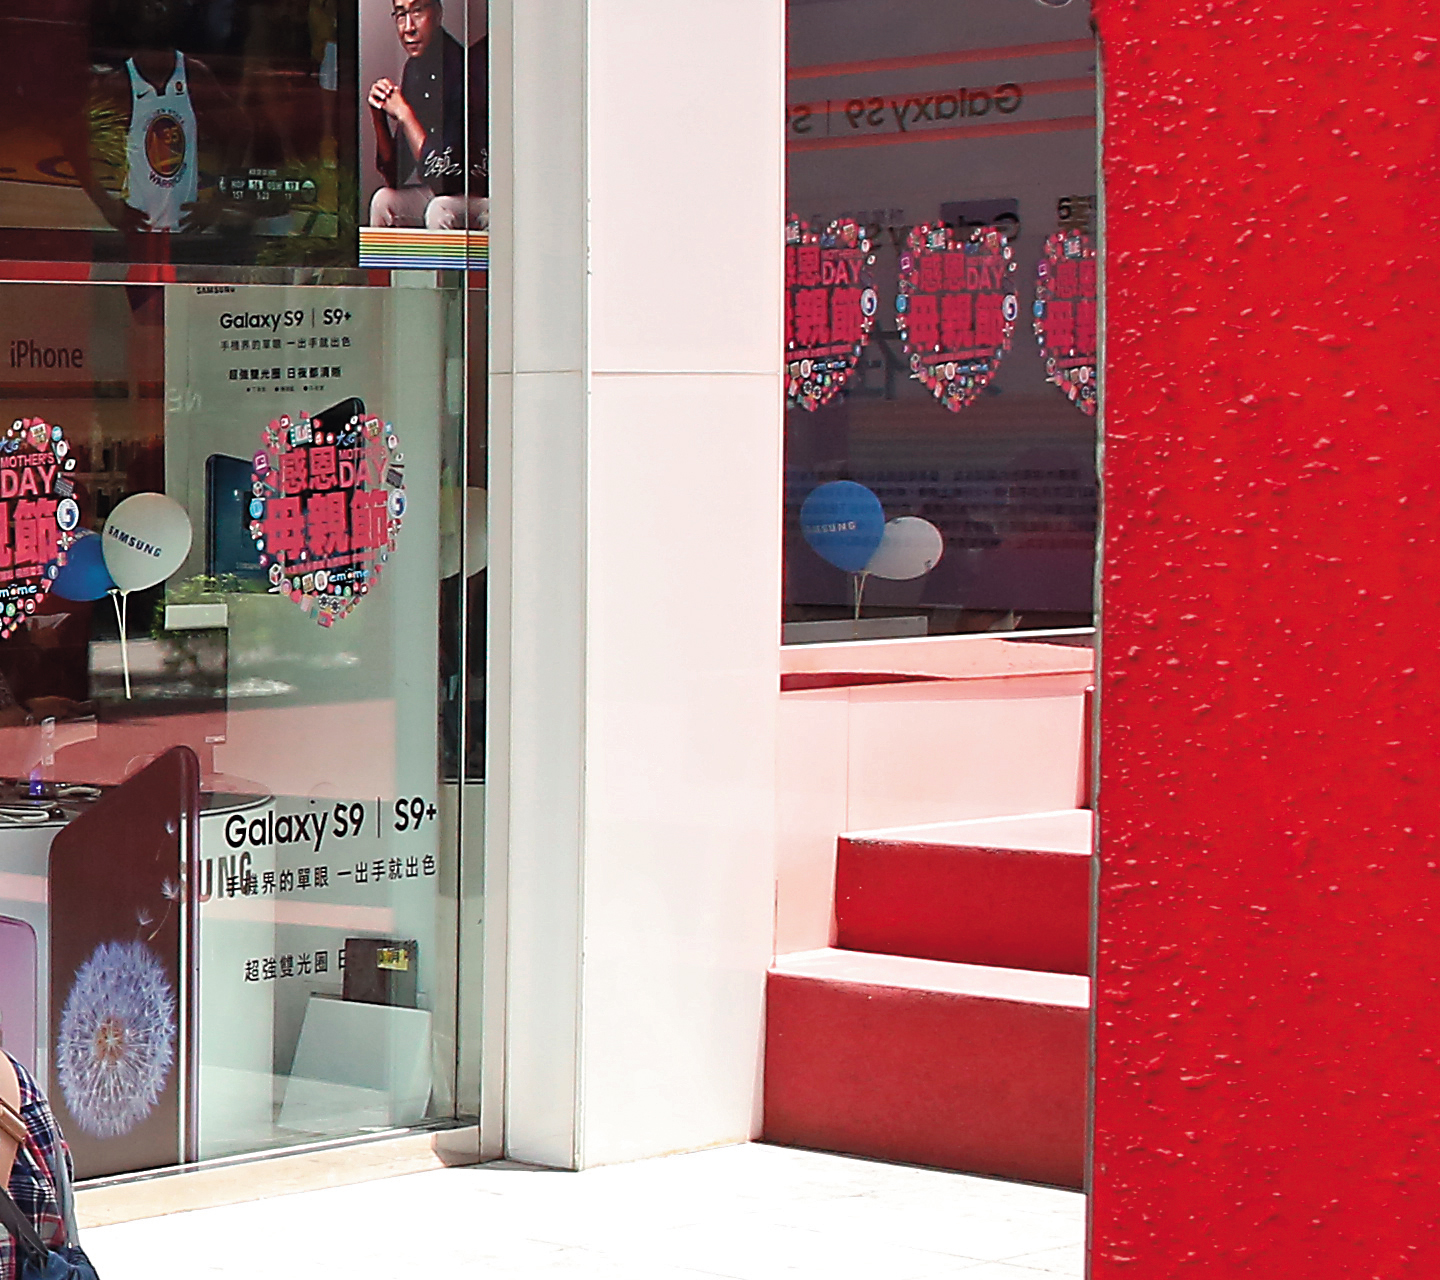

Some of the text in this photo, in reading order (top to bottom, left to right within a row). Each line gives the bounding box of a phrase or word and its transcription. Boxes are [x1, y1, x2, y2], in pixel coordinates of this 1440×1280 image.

[220, 308, 352, 332] Galaxy S9 S9+
[10, 340, 84, 369] iPhone
[0, 452, 55, 470] MOTHER'S
[338, 456, 388, 490] DAY
[0, 465, 57, 499] DAY
[108, 525, 162, 558] SAMSUNG
[225, 797, 437, 852] Galaxy S9 S9+
[225, 866, 329, 899] 手機界的單眼
[336, 853, 437, 884] 一出手就出色
[243, 950, 328, 983] 超強雙光圈
